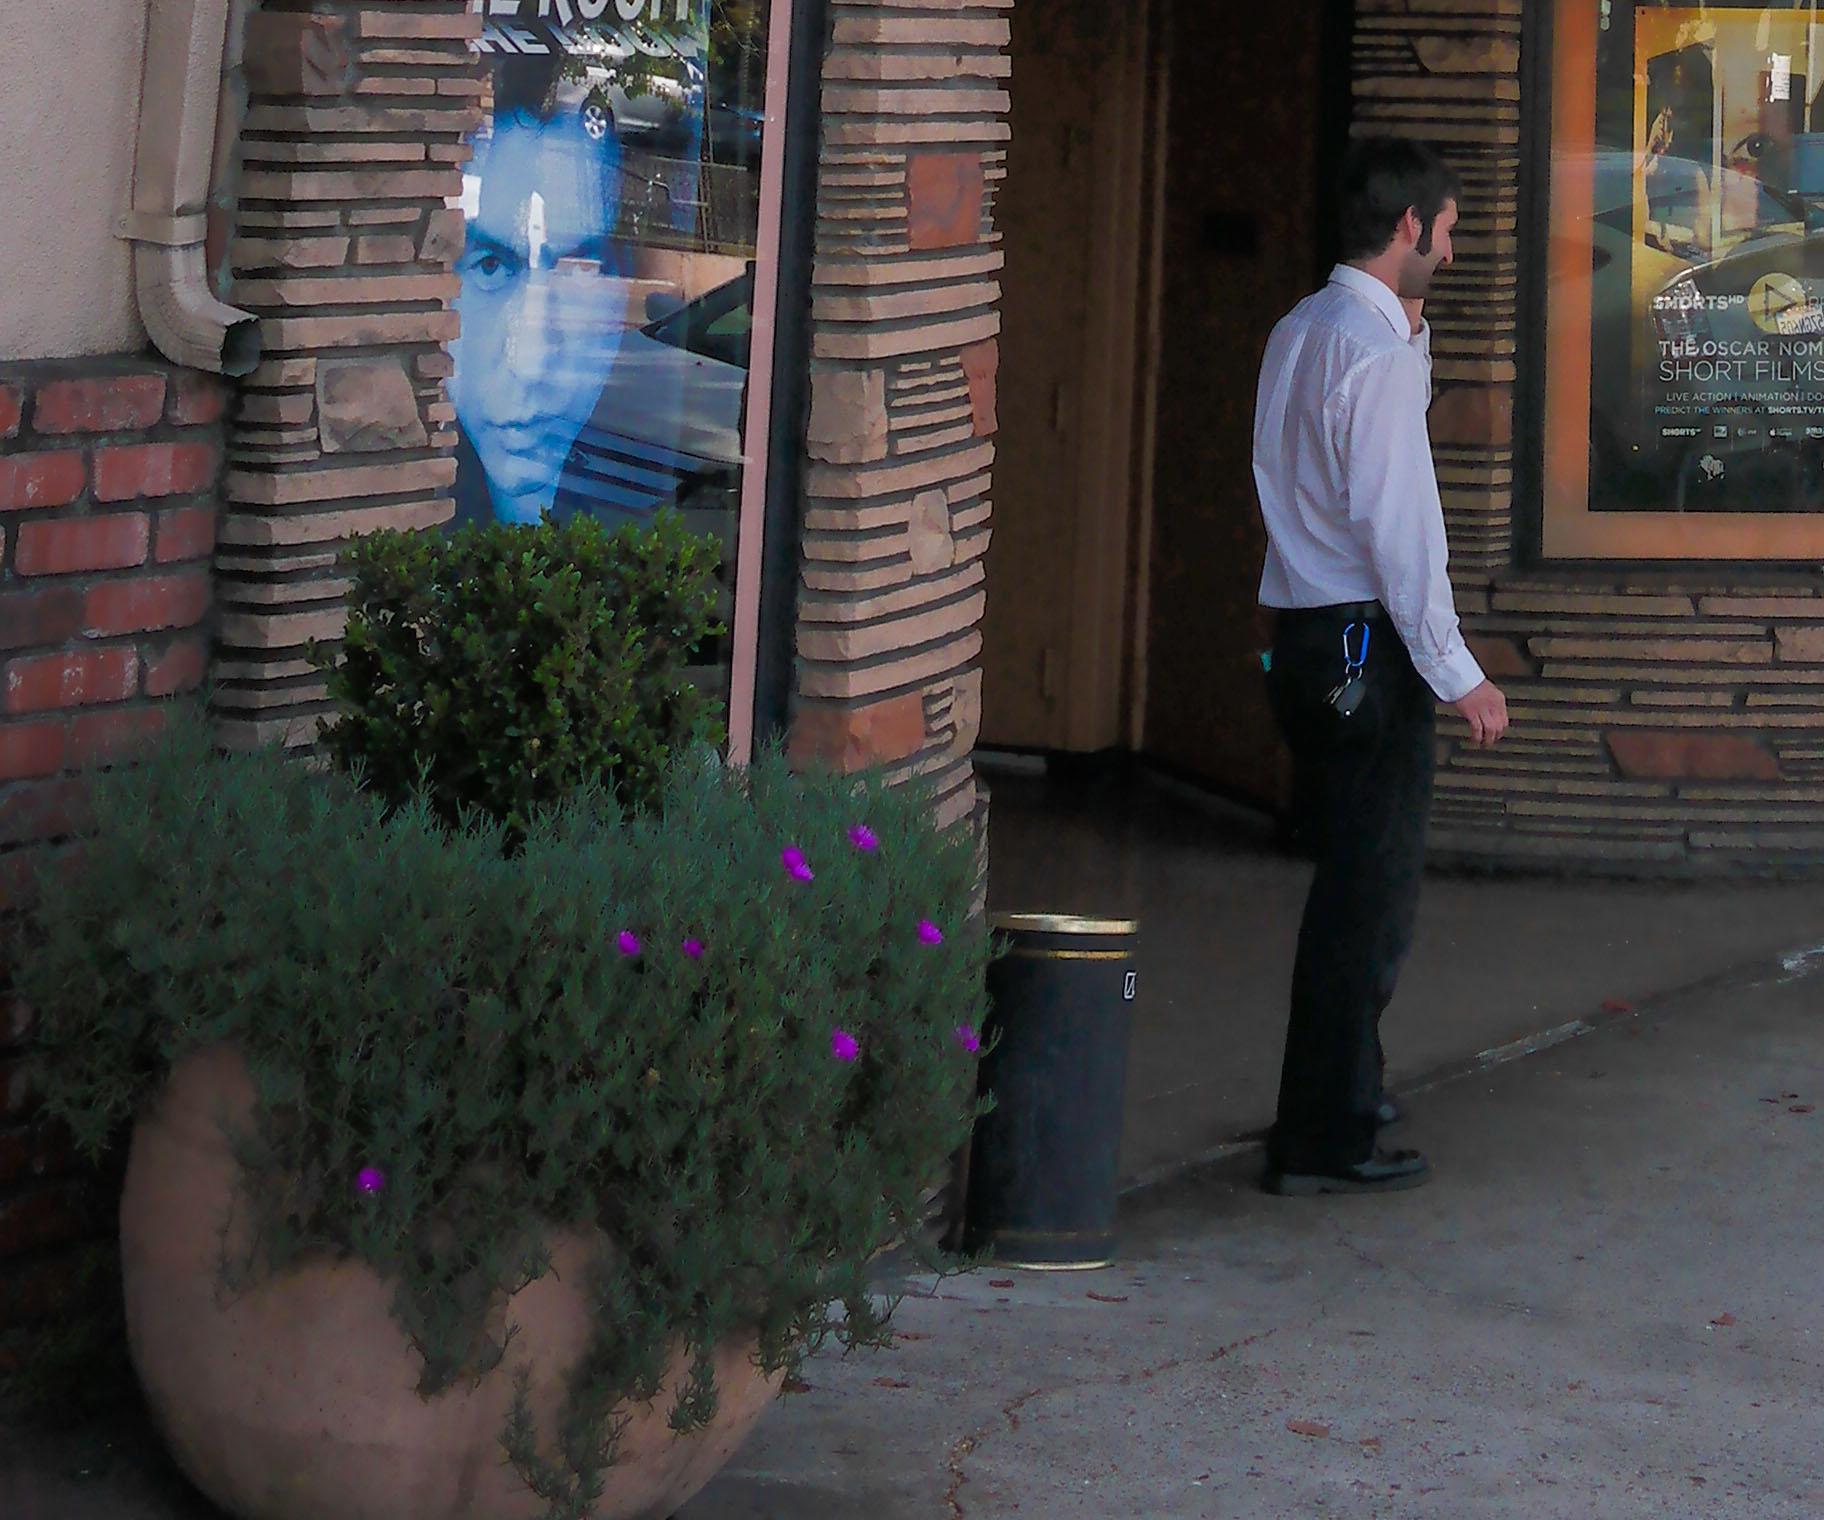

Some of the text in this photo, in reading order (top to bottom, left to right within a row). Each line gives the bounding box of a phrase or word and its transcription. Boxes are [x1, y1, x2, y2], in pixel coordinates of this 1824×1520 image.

[1659, 340, 1699, 356] THE
[1659, 361, 1747, 381] SHORT
[1666, 392, 1690, 401] LIVE
[1693, 392, 1732, 401] ACTION
[1740, 392, 1798, 401] ANIMATION
[1694, 406, 1710, 414] THE
